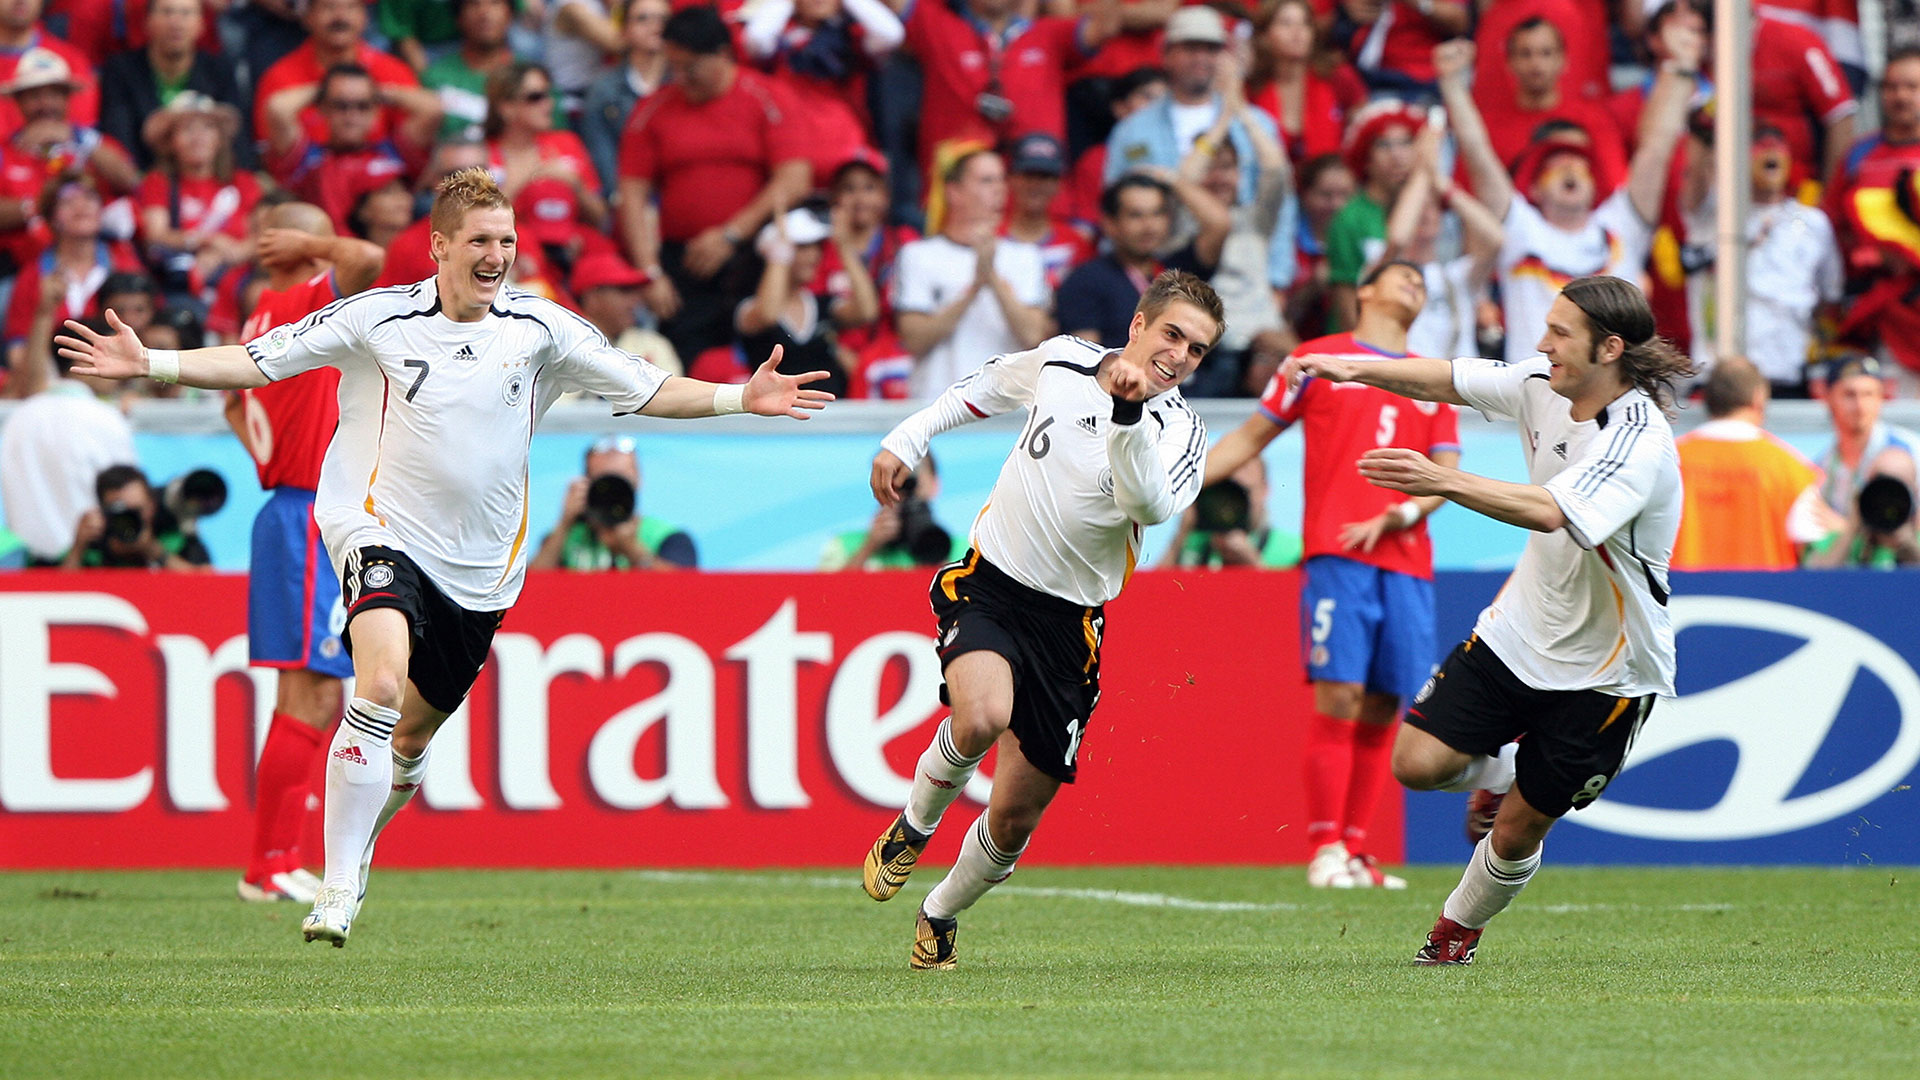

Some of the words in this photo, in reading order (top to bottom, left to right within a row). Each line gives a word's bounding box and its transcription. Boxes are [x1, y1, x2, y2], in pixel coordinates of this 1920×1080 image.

[452, 354, 479, 363] adidas
[404, 359, 430, 403] 7
[1019, 405, 1055, 460] 16
[1375, 404, 1398, 446] 5
[1312, 598, 1336, 643] 5
[0, 592, 992, 812] Emrate
[333, 751, 367, 765] adidas
[1571, 774, 1608, 803] 8
